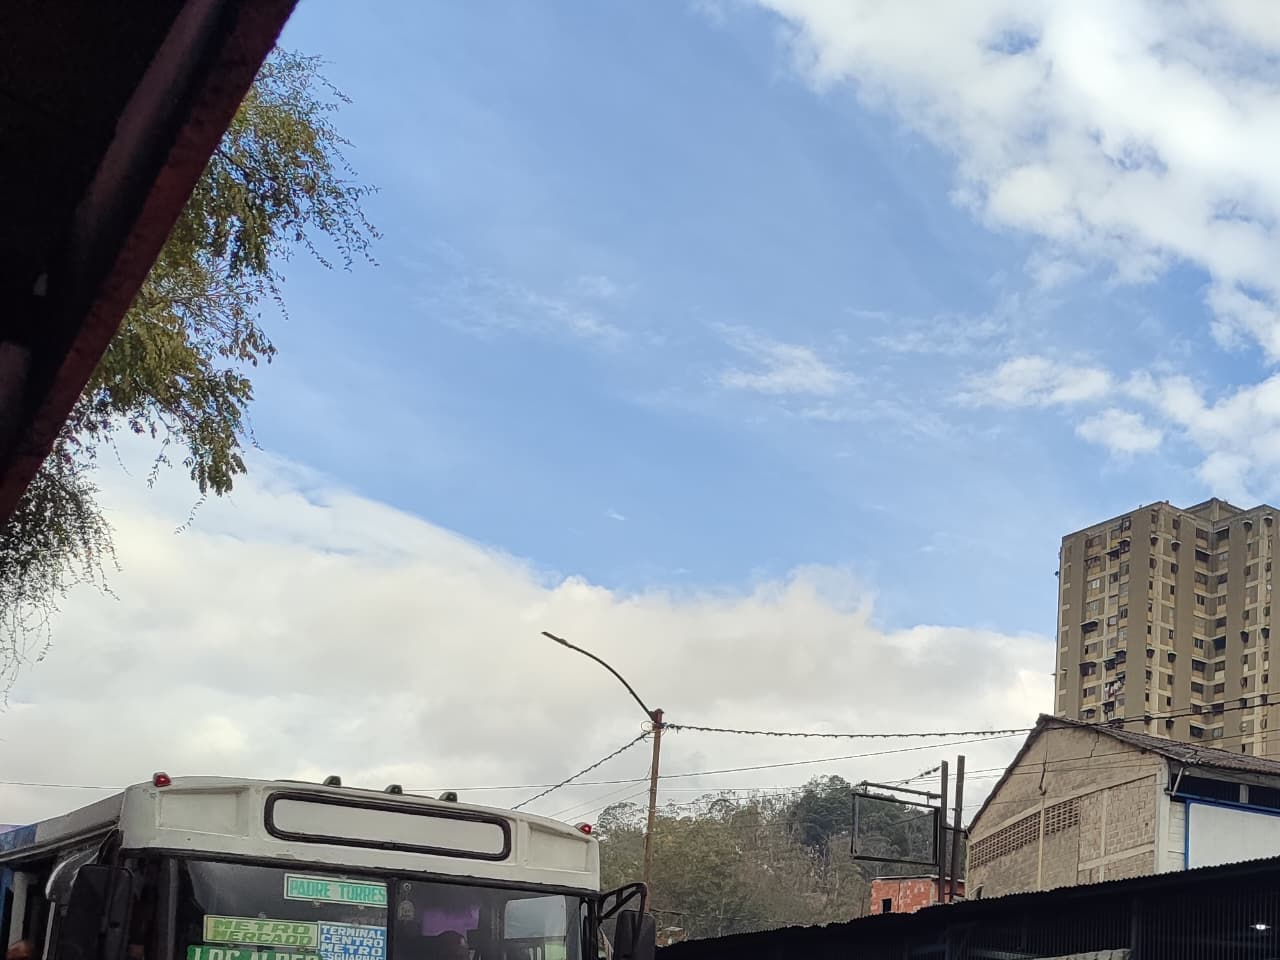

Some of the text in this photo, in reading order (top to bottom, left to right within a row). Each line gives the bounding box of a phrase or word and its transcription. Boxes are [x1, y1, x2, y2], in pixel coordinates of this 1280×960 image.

[289, 879, 385, 904] PADRE TORRES
[212, 919, 310, 934] METRO
[321, 925, 385, 940] TERMINAL
[212, 929, 313, 946] MERCADO
[320, 934, 384, 948] CENTRO
[320, 942, 383, 956] METRO
